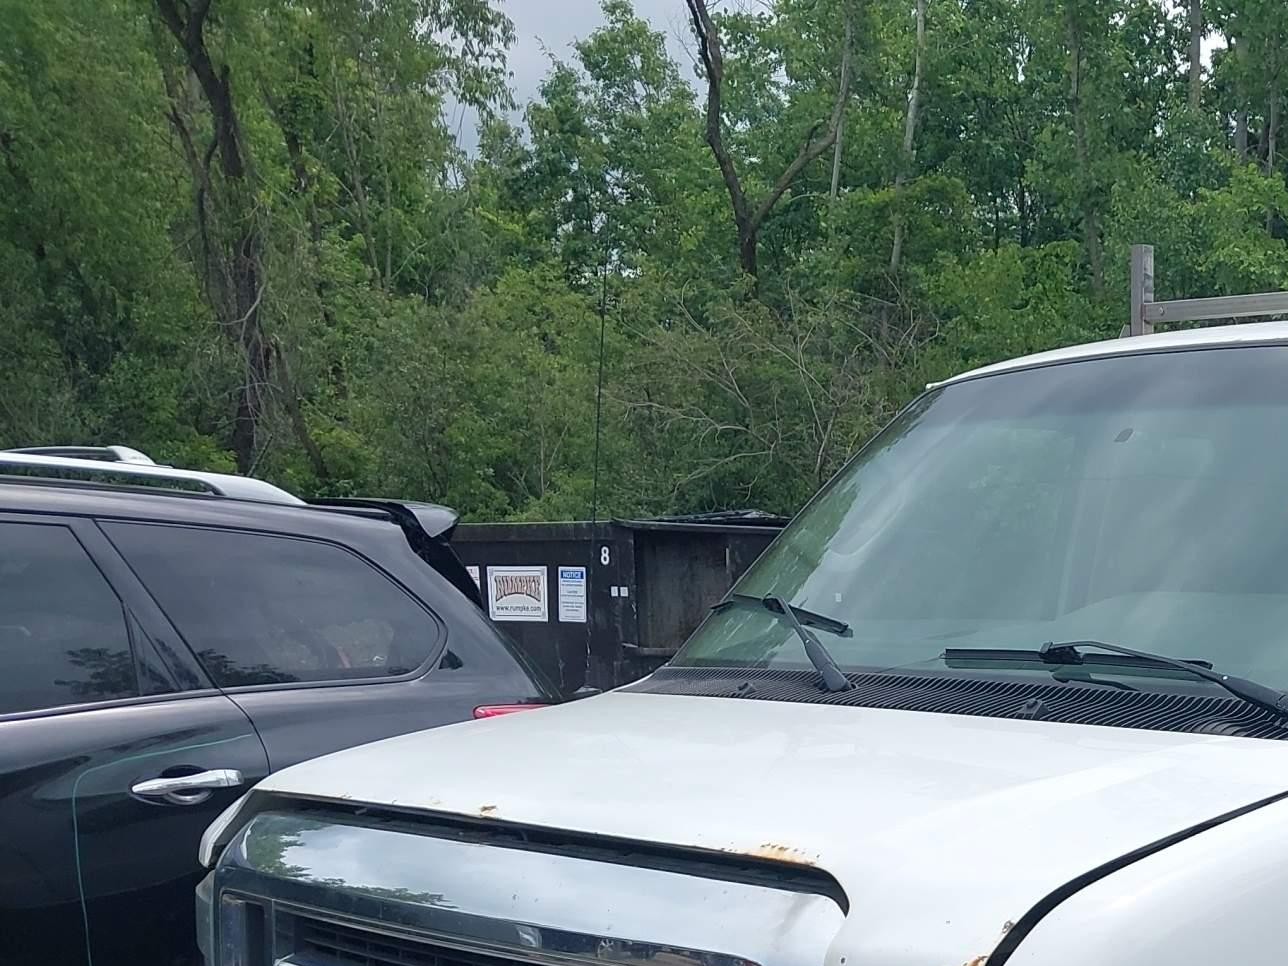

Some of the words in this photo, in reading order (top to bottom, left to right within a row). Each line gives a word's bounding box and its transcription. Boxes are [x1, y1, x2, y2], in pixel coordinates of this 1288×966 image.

[601, 546, 610, 565] 8
[562, 571, 582, 579] NOTICE
[495, 575, 541, 602] RUMPKE
